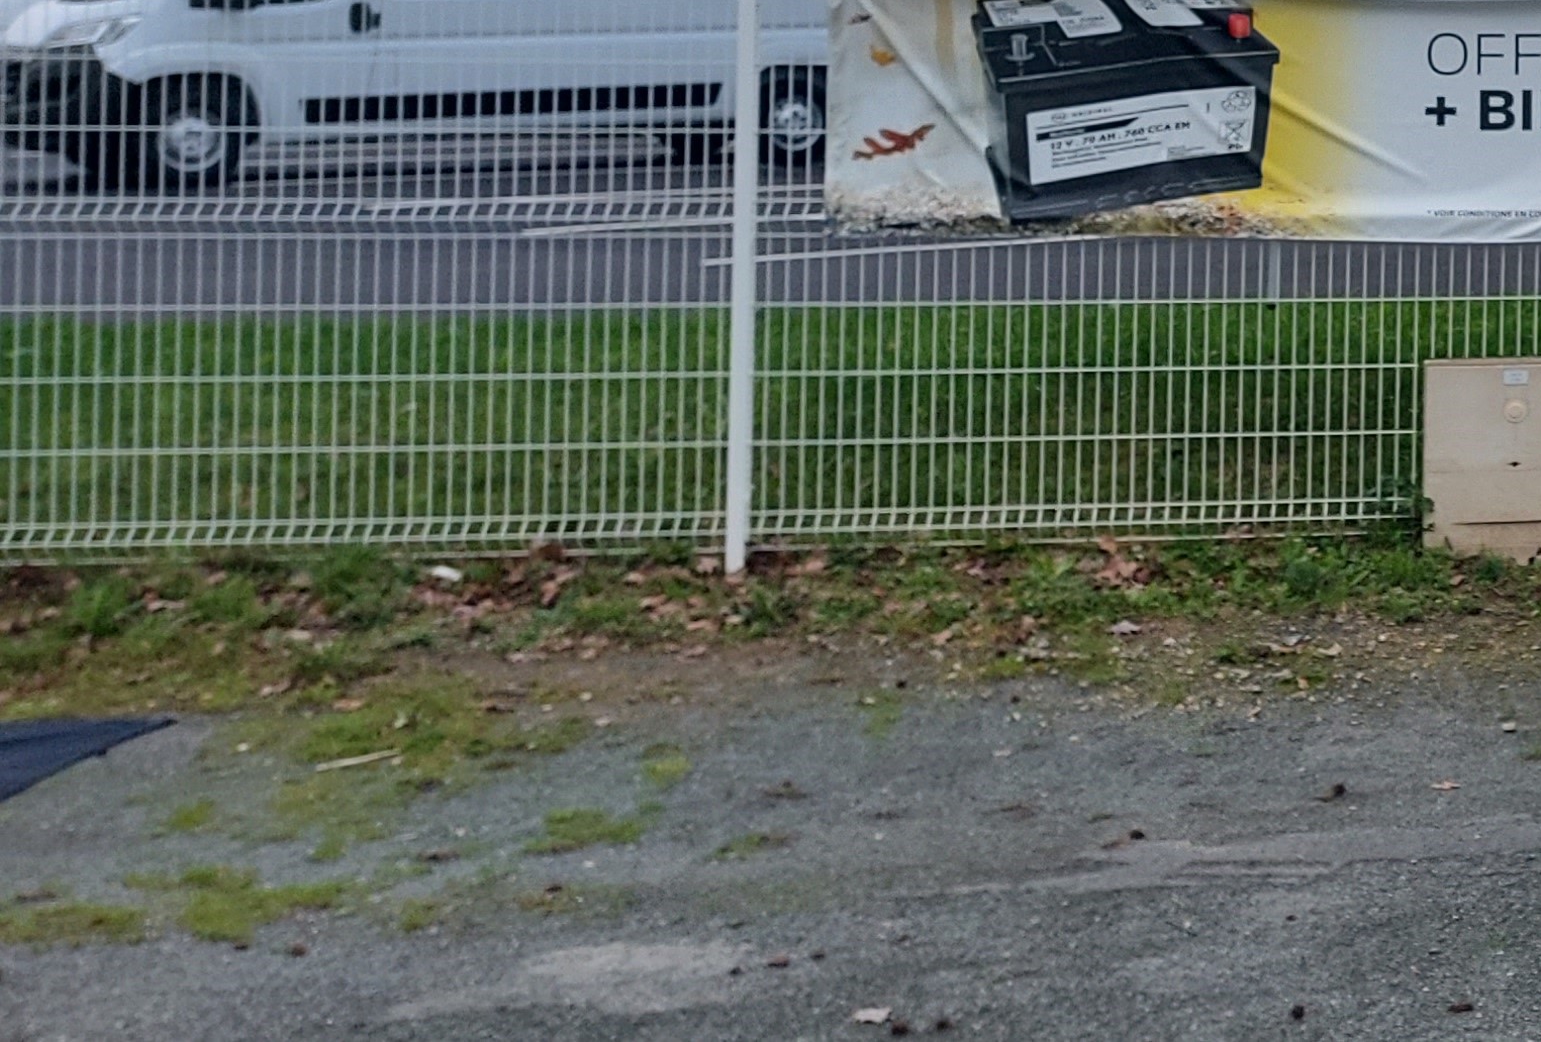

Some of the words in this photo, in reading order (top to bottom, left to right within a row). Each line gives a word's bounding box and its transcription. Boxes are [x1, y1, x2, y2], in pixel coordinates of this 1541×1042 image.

[1425, 97, 1457, 126] +
[1434, 209, 1455, 217] VOIR
[1457, 209, 1512, 218] CONDITIONS
[1515, 210, 1526, 218] EN
